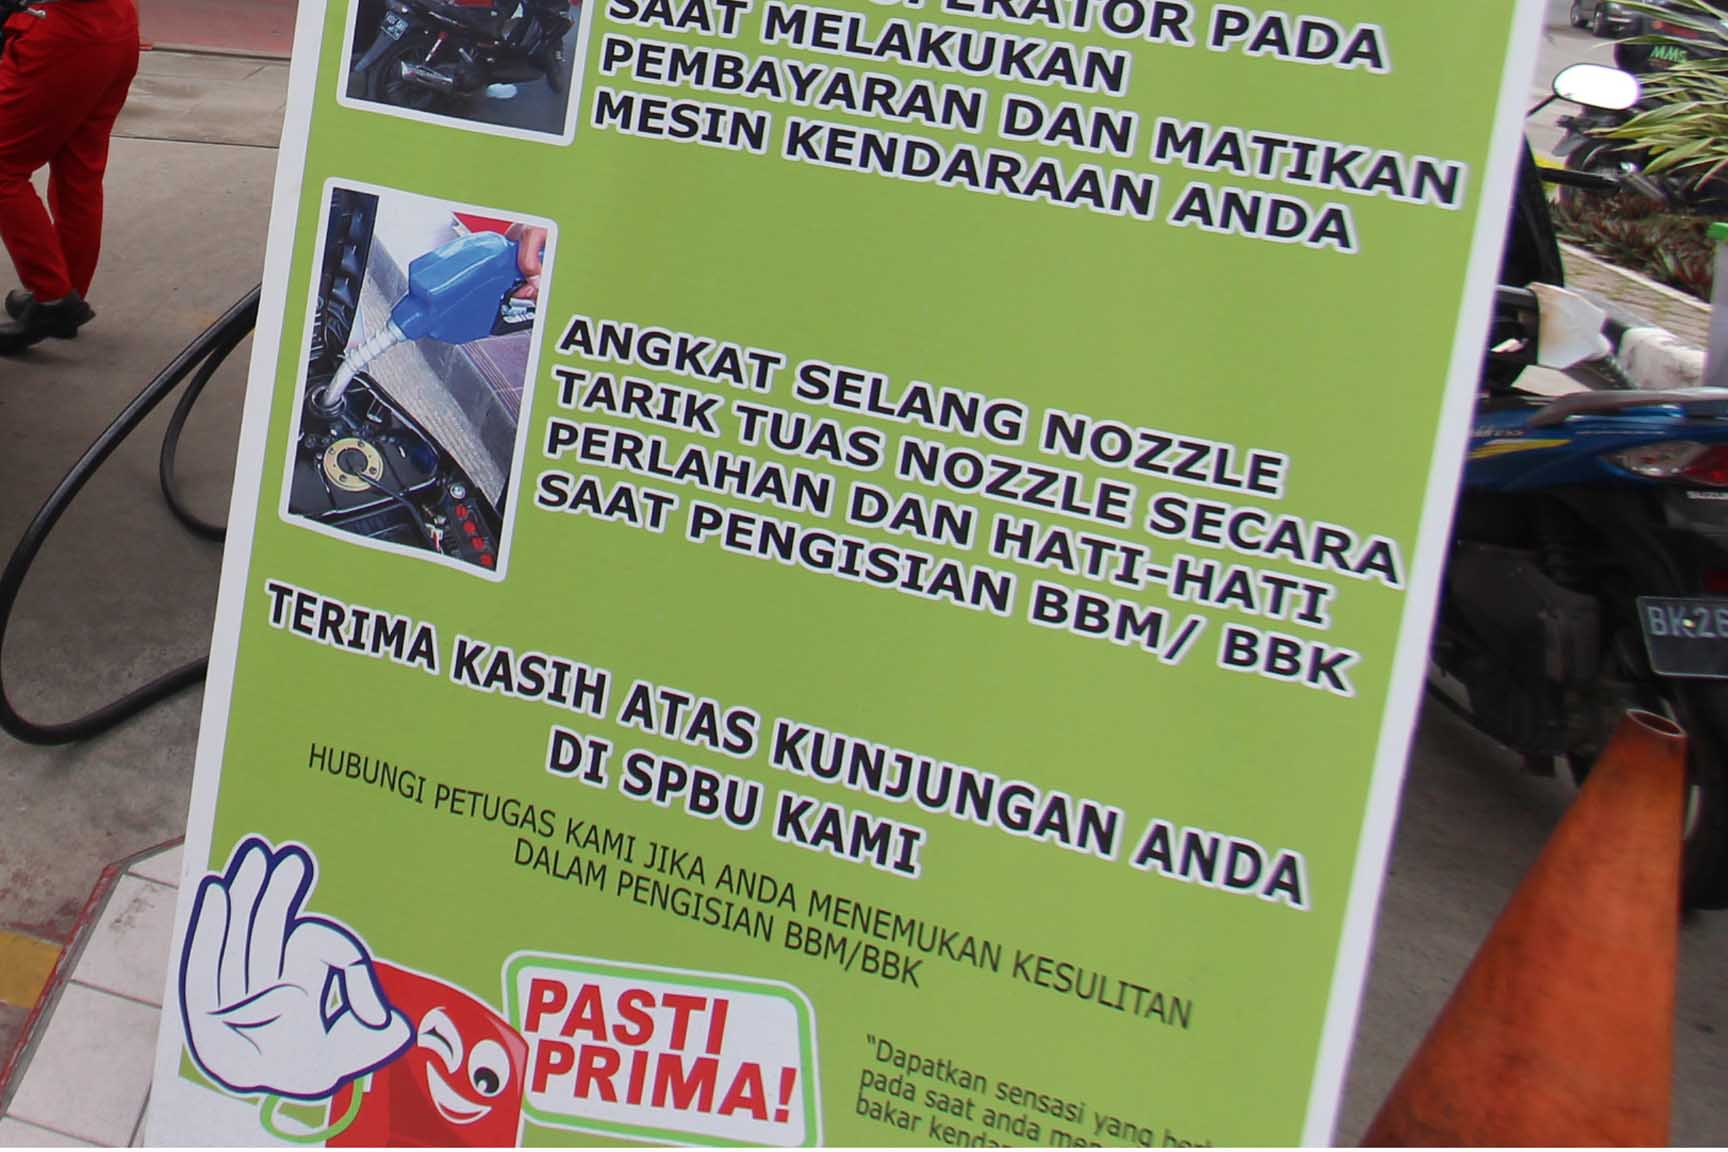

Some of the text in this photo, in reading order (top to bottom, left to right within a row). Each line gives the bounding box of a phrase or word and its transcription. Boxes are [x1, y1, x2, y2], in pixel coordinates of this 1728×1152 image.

[763, 3, 1128, 94] MELAKUKAN
[1210, 7, 1385, 71] PADA
[593, 89, 1353, 251] MESIN KENDARAAN ANDA
[601, 35, 1461, 206] PEMBAYARAN DAN MATIKAN
[553, 367, 1400, 586] TARIK TUAS NOZZLE SECARA
[558, 317, 1284, 496] ANGKAT SELANG NOZZLE
[536, 472, 1353, 693] SAAT PENGISIAN BBM/ BBK
[545, 419, 1330, 626] PERLAHAN DAN HATI-HATI
[266, 581, 1303, 906] TERIMA KASIH ATAS KUNJUNGAN ANDA
[547, 727, 922, 876] DI SPBU KAMI
[307, 741, 1193, 1030] HUBUNGI PETUGAS KAMI JIKA ANDA MENEMUKAN KESULITAN
[513, 836, 924, 990] DALAM PENGISIAN BBM/BBK
[524, 978, 728, 1055] PASTI
[531, 1039, 796, 1123] PRIMA!
[855, 1097, 922, 1133] bakar
[859, 1067, 917, 1100] pada
[924, 1088, 976, 1121] saat
[982, 1108, 1041, 1142] anda
[996, 1080, 1085, 1124] sensasi
